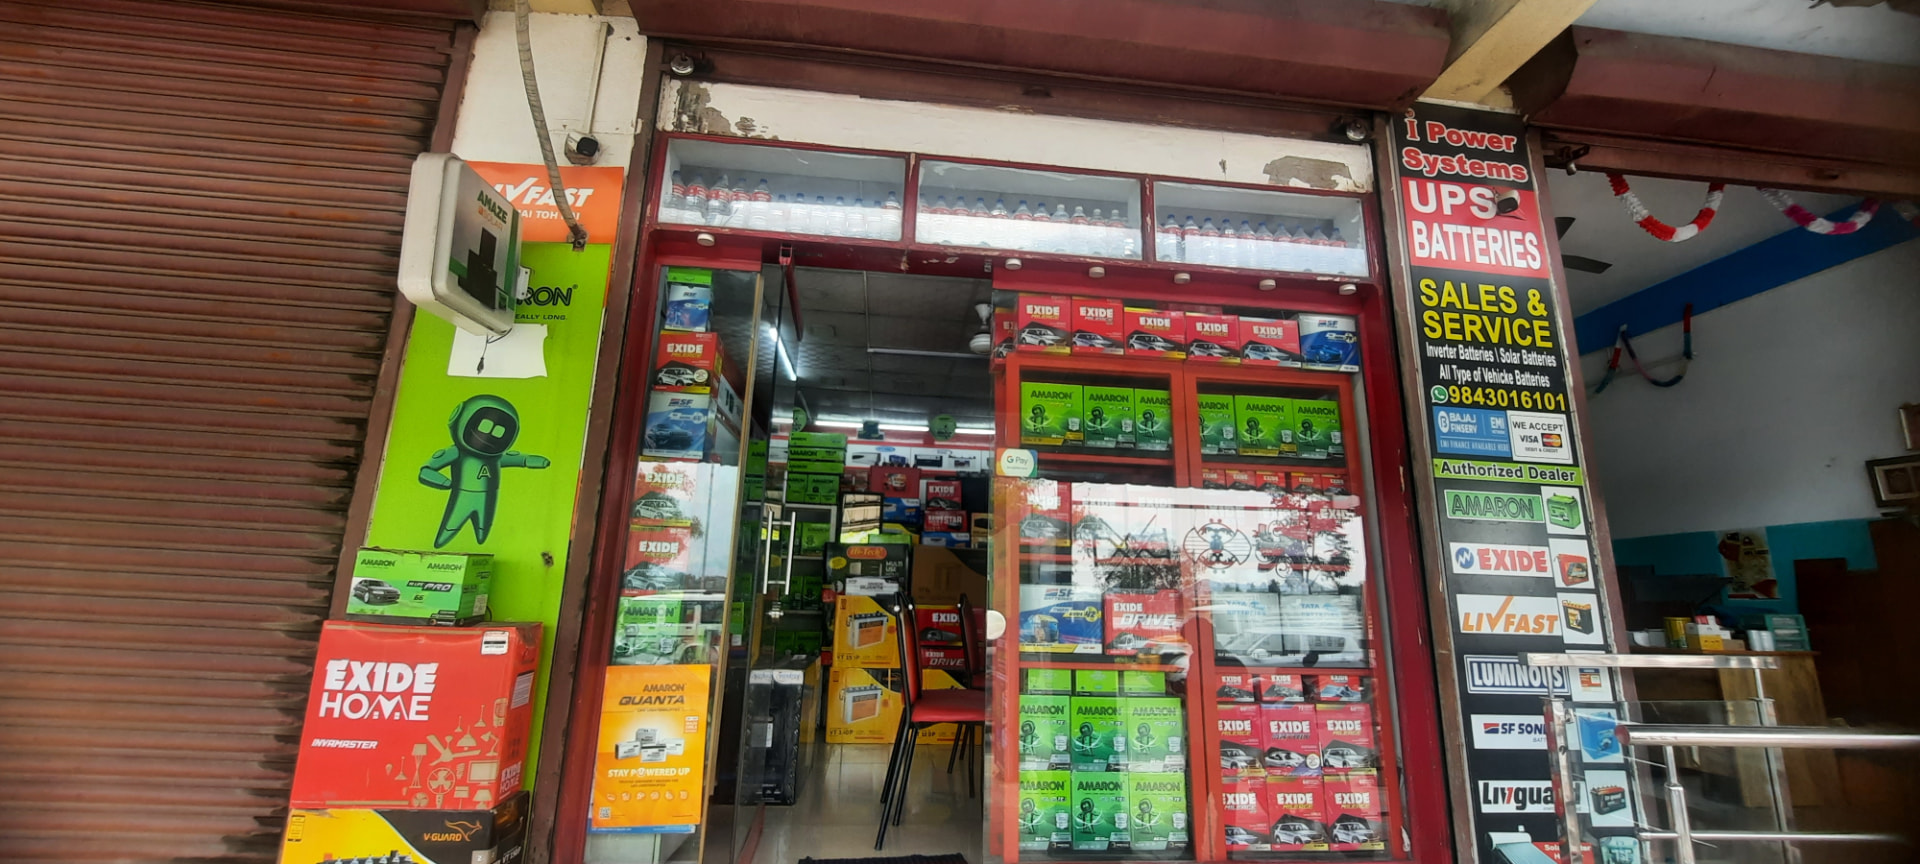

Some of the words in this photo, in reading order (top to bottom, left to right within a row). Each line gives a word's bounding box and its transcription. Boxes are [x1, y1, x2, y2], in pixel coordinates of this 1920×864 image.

[1426, 121, 1517, 153] Power
[1402, 147, 1528, 182] Systems
[1408, 180, 1497, 219] UPS
[477, 190, 508, 224] AMAZE
[536, 210, 558, 219] TOH
[1411, 220, 1541, 270] BATTERIES
[1419, 278, 1518, 314] SALES
[1527, 288, 1548, 317] &
[1026, 304, 1060, 315] EXIDE
[1080, 307, 1113, 318] EXIDE
[1139, 317, 1171, 327] EXIDE
[1196, 322, 1228, 332] EXIDE
[1253, 326, 1283, 335] EXIDE
[1422, 310, 1553, 348] SERVICE
[667, 343, 704, 354] EXIDE
[1425, 342, 1457, 359] Inverter
[1458, 344, 1494, 362] Batteries
[1499, 347, 1521, 365] Solar
[1521, 349, 1557, 367] Batteries
[1440, 364, 1451, 380] All
[1451, 365, 1472, 385] Type
[1473, 367, 1482, 382] of
[1482, 367, 1514, 385] Vehicke
[1514, 369, 1551, 388] Batteries
[1030, 390, 1073, 400] AMARON
[1089, 394, 1129, 403] AMARON
[1449, 385, 1566, 411] 9843016101
[1140, 396, 1171, 406] AMARO
[1198, 401, 1229, 411] MARON
[1245, 402, 1284, 413] AMARON
[1298, 406, 1336, 416] AMARON
[1449, 412, 1477, 424] BAJAJ
[1490, 416, 1505, 429] EMI
[1450, 423, 1478, 434] FINSERV
[1512, 421, 1527, 430] WE
[1529, 422, 1564, 432] ACCEPT
[1520, 435, 1539, 443] VISA
[1006, 455, 1014, 464] G
[1015, 456, 1028, 466] Pay
[1441, 460, 1524, 479] Authorized
[1528, 466, 1576, 482] Dealer
[645, 472, 685, 484] EXIDE
[928, 485, 955, 494] EXIDE
[1451, 494, 1535, 519] AMARON
[639, 540, 680, 554] EXIDE
[360, 559, 396, 567] AMARON
[1477, 547, 1548, 573] EXIDE
[427, 563, 462, 571] AMARON
[424, 583, 453, 591] PRO
[1113, 602, 1143, 612] EXIDE
[932, 612, 961, 623] EXID
[1120, 613, 1177, 626] DRIVE
[1462, 595, 1559, 634] LIVFAST
[929, 658, 965, 666] DRIVE
[323, 658, 440, 694] EXIDE
[642, 684, 685, 693] AMARON
[618, 695, 685, 706] QUANTA
[319, 692, 432, 721] HOME
[1019, 705, 1065, 715] AMARON
[1076, 706, 1121, 716] AMARON
[1270, 720, 1310, 733] EXIDE
[1326, 720, 1361, 731] EXIDE
[1501, 723, 1515, 735] SF
[1518, 723, 1547, 735] SONI
[311, 738, 378, 750] INVAMASTER
[608, 769, 630, 778] STAY
[630, 767, 677, 777] POWERED
[678, 767, 691, 776] UP
[1077, 781, 1123, 791] AMARON
[1135, 782, 1180, 792] AMARON
[1276, 792, 1313, 805] EXIDE
[1334, 792, 1370, 805] EXIDE
[423, 832, 462, 842] V-GUARD
